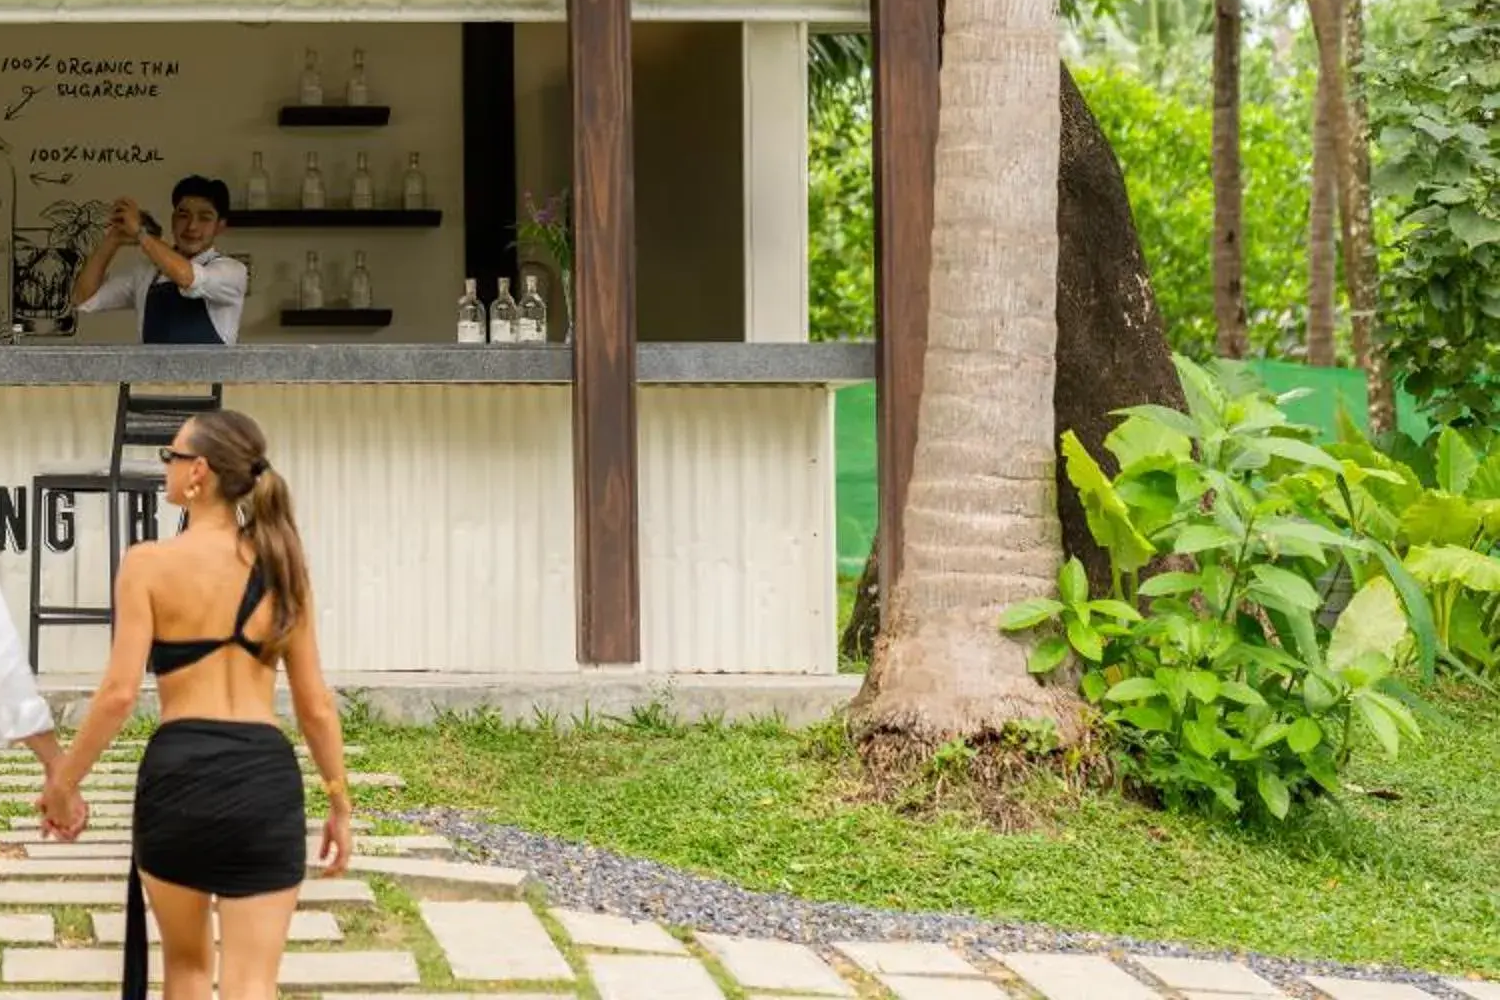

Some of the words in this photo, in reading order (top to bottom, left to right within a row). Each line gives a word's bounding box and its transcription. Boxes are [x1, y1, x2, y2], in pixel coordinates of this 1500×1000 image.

[1, 55, 51, 73] 100%
[57, 58, 133, 75] ORGANIC
[141, 61, 179, 77] THAI
[57, 80, 160, 98] SUGARCANE
[30, 146, 77, 164] 100%
[83, 145, 164, 163] NATURAL
